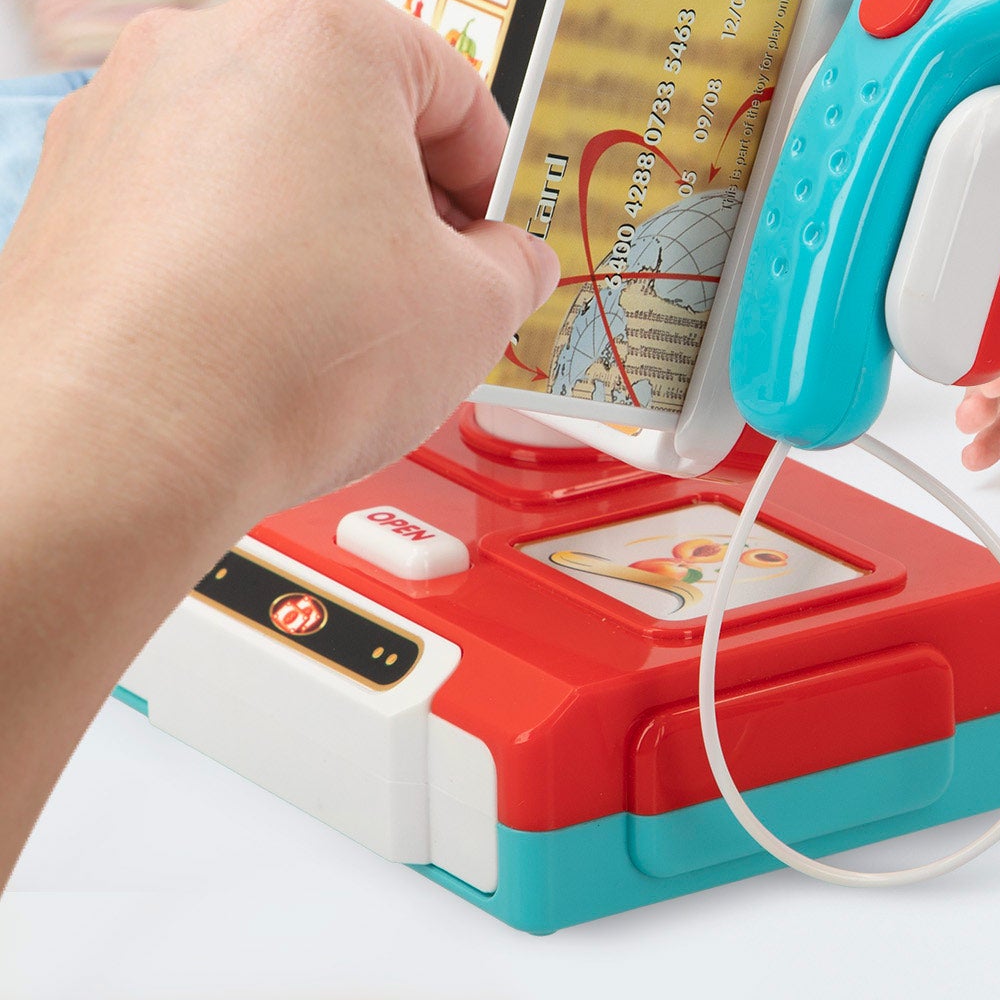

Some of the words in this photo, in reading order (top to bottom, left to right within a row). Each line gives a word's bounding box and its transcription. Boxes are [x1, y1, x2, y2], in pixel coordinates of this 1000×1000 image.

[767, 21, 785, 50] play
[759, 51, 773, 71] for
[753, 72, 770, 95] toy
[747, 99, 762, 120] the
[678, 170, 697, 197] 05
[693, 79, 722, 143] 09/08
[744, 120, 756, 137] of
[605, 223, 636, 290] 6400
[624, 152, 656, 219] 4288
[643, 81, 675, 145] 0733
[663, 9, 696, 74] 5463
[736, 138, 750, 166] part
[729, 169, 742, 181] is
[526, 153, 569, 240] Card
[721, 184, 738, 210] This
[366, 511, 435, 542] OPEN
